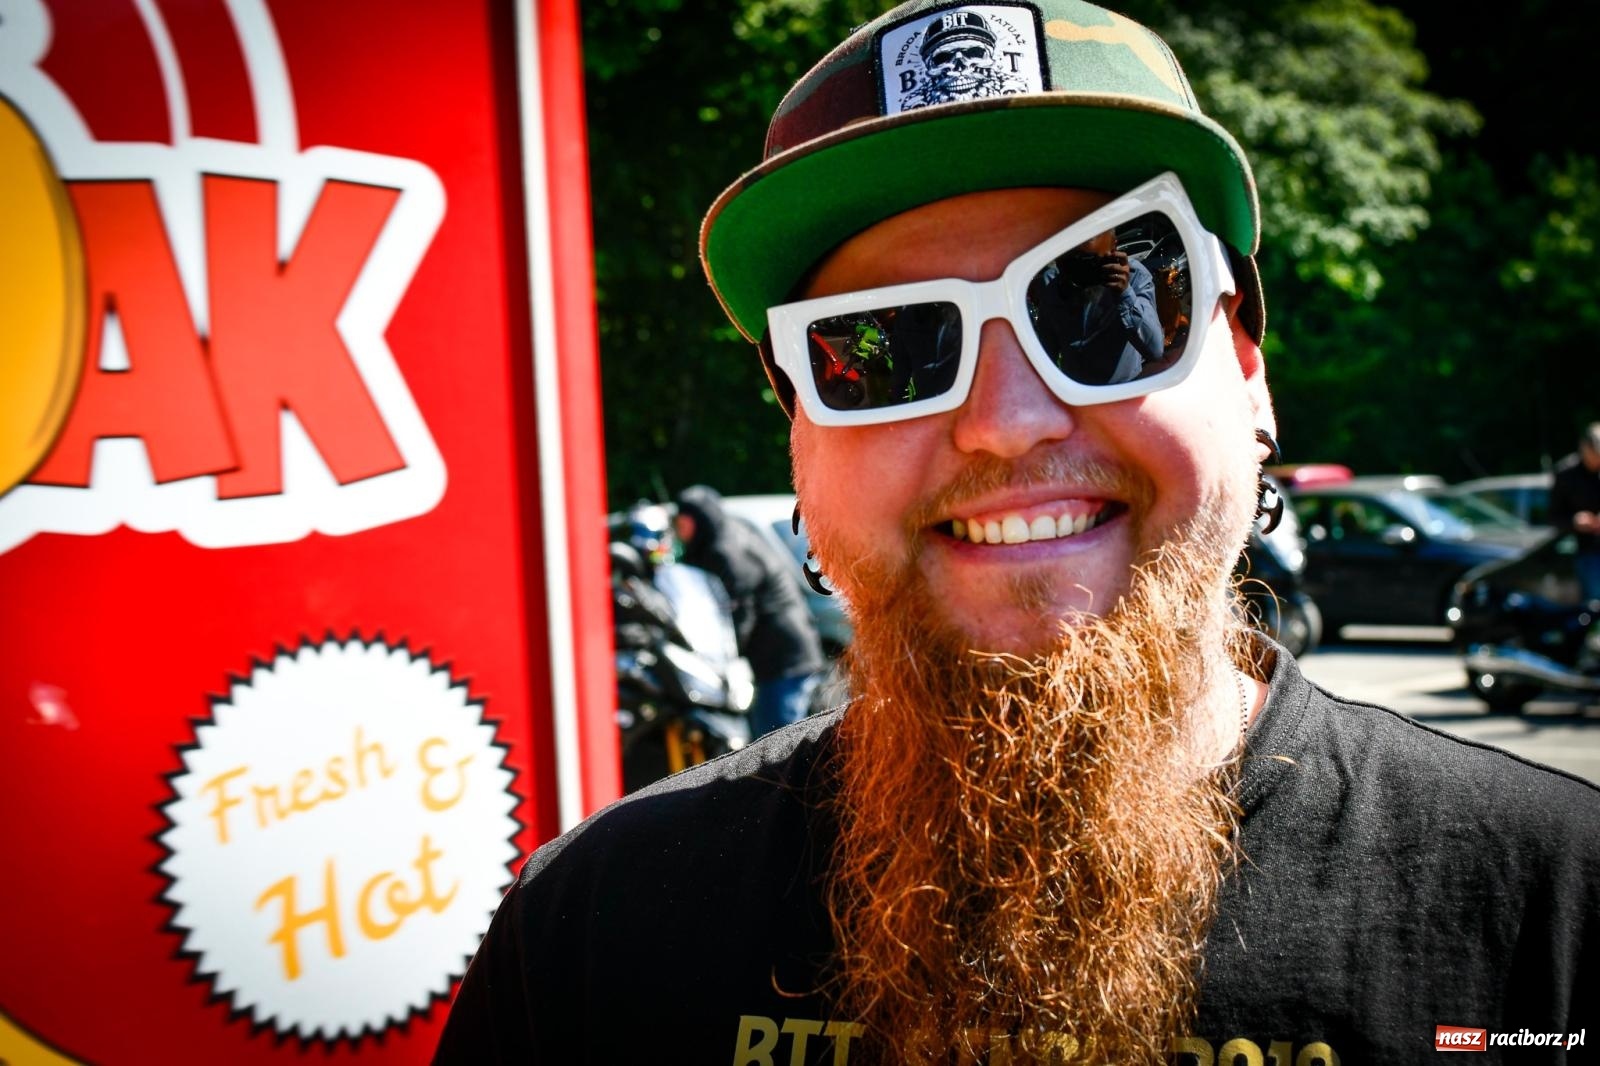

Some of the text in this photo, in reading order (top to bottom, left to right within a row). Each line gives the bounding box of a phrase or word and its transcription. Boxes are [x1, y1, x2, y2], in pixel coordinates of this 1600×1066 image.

[942, 12, 970, 31] BIT
[899, 51, 1024, 93] B T
[201, 725, 475, 844] Fresh &
[253, 834, 464, 982] Hot
